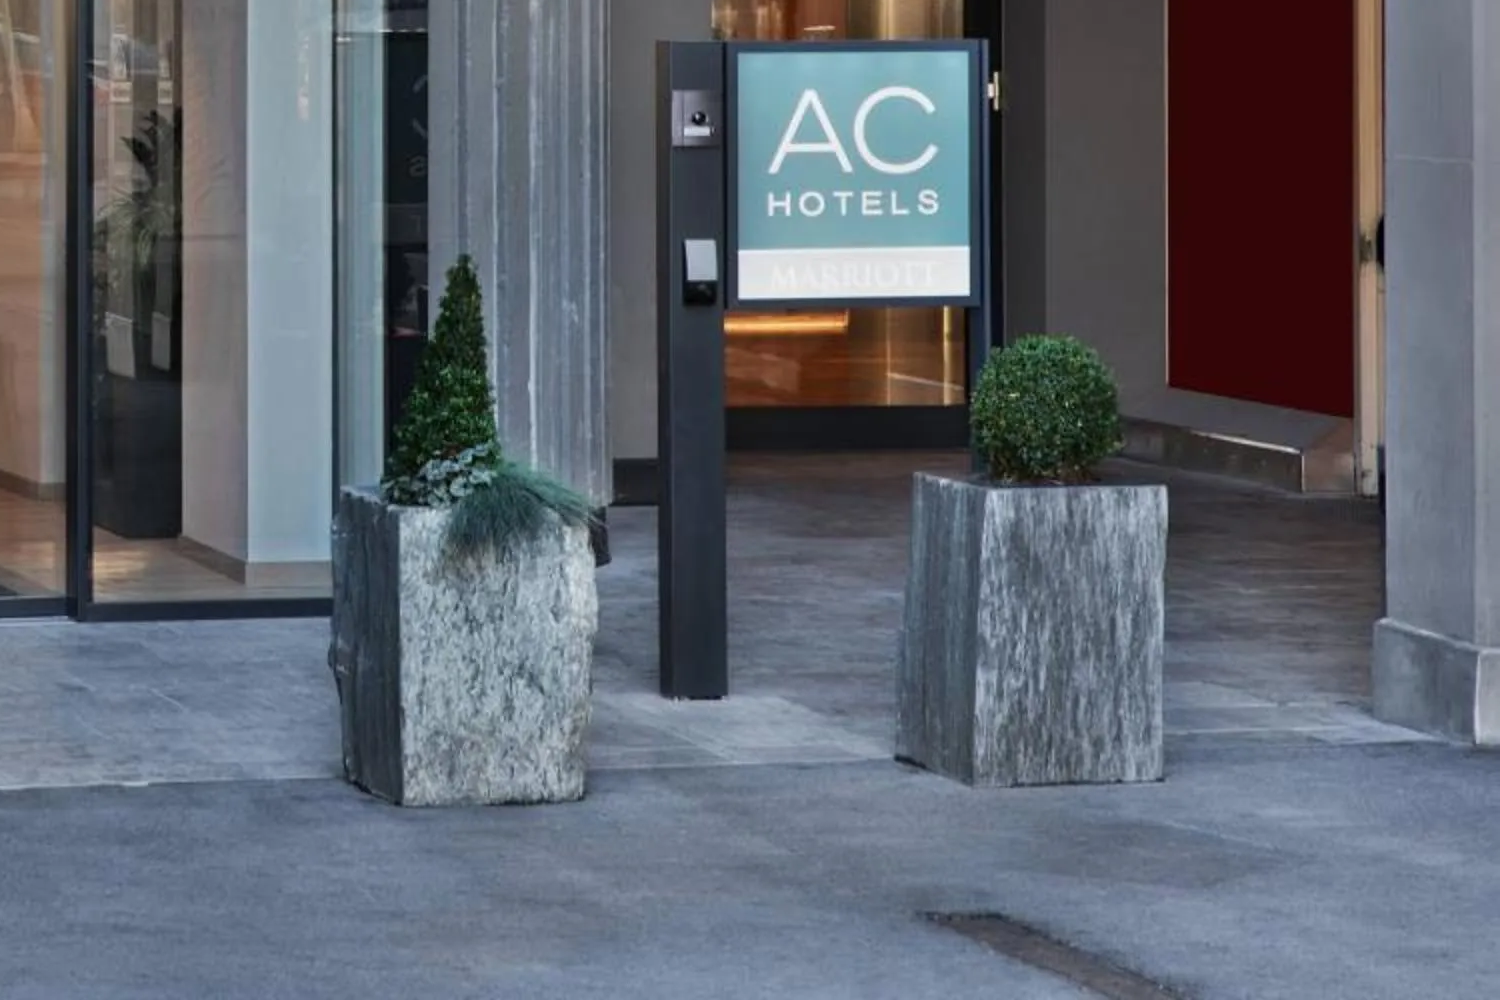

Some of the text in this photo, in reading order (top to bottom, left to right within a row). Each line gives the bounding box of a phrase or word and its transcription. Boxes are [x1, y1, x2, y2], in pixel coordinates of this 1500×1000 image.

[767, 85, 939, 175] AC
[767, 189, 940, 217] HOTELS
[770, 260, 940, 291] MARRIOTT
